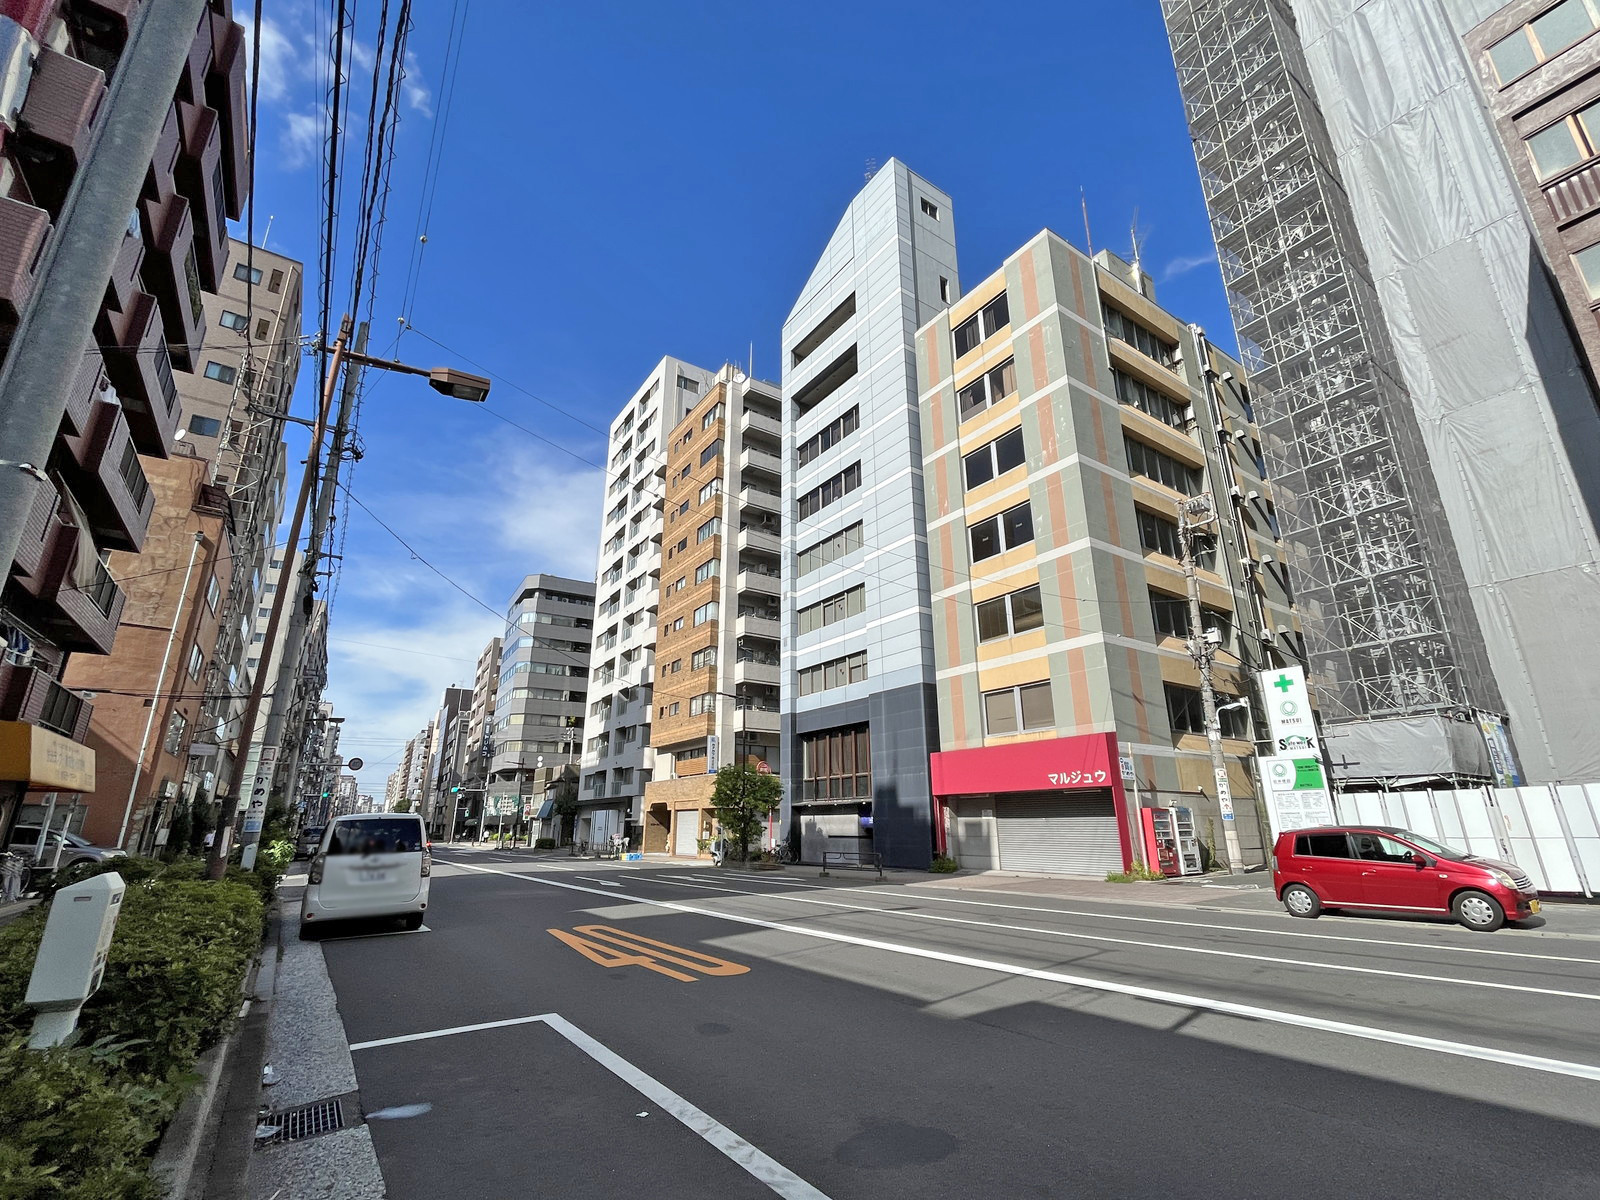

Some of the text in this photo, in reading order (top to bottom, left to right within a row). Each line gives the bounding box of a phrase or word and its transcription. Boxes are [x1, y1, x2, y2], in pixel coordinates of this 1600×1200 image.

[1048, 770, 1106, 785] マルジュウ
[251, 776, 269, 809] かめや
[1218, 782, 1228, 803] かめや
[546, 924, 751, 983] 40
